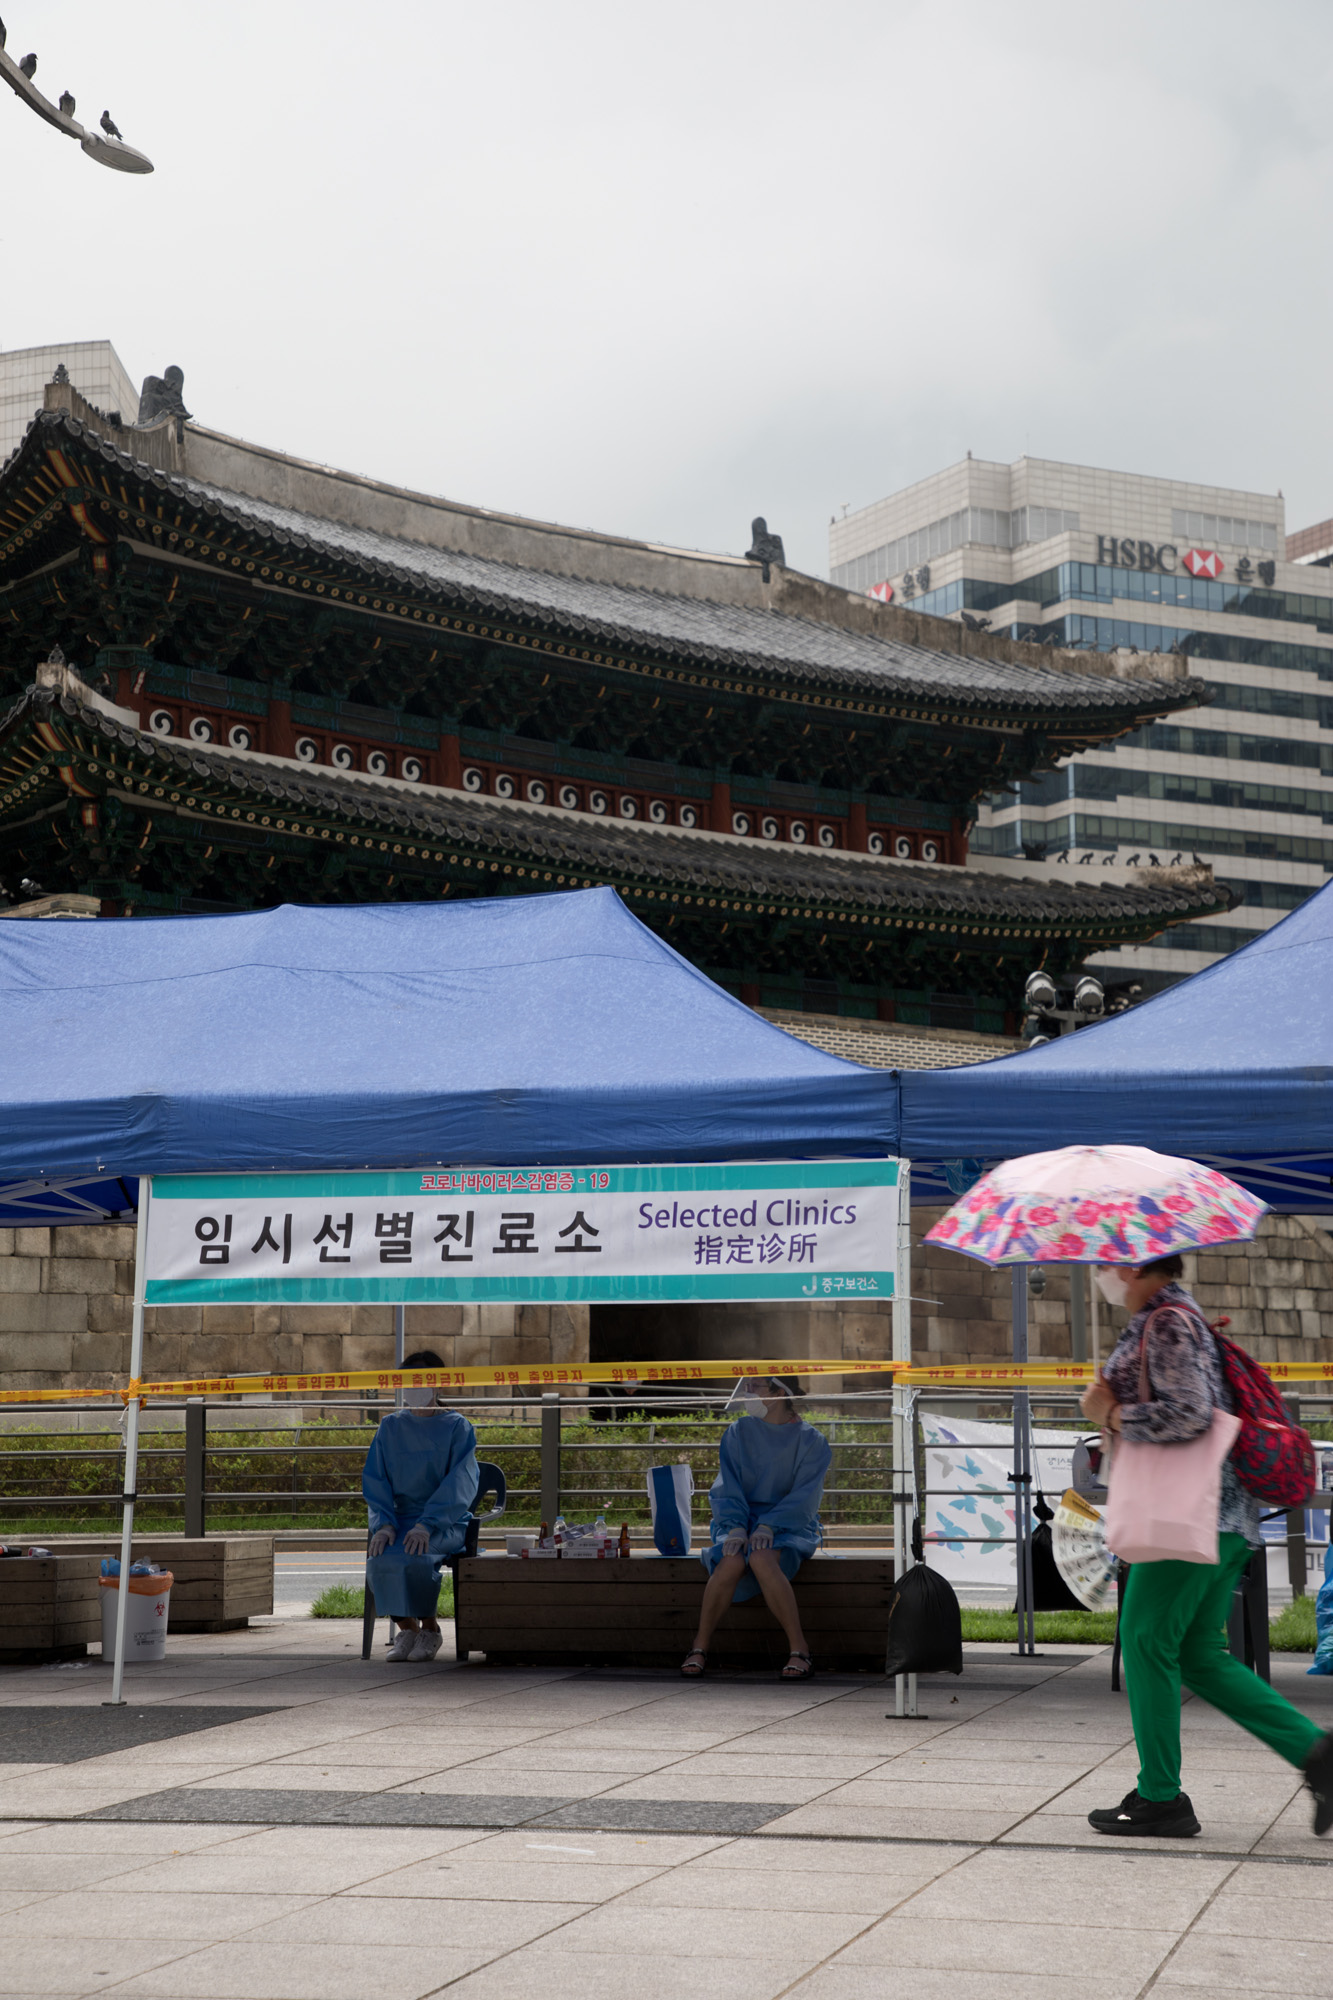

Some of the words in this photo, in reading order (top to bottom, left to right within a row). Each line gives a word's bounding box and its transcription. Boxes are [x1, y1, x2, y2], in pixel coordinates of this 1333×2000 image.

[1097, 535, 1178, 573] HSBC
[420, 1172, 574, 1192] 코로나바이러스감염증
[638, 1199, 757, 1229] Selected
[766, 1198, 857, 1227] Clinics
[195, 1210, 602, 1265] 임시선별진료소
[693, 1232, 818, 1265] 指定诊所
[821, 1277, 879, 1293] 중구보건소
[263, 1378, 288, 1391] 위험
[297, 1375, 350, 1389] 출입금지
[378, 1374, 403, 1388] 위험
[412, 1373, 465, 1387] 출입금지
[494, 1371, 520, 1385] 위험
[529, 1370, 583, 1384] 출입금지
[611, 1369, 638, 1381] 위험
[647, 1367, 703, 1379] 출입금지
